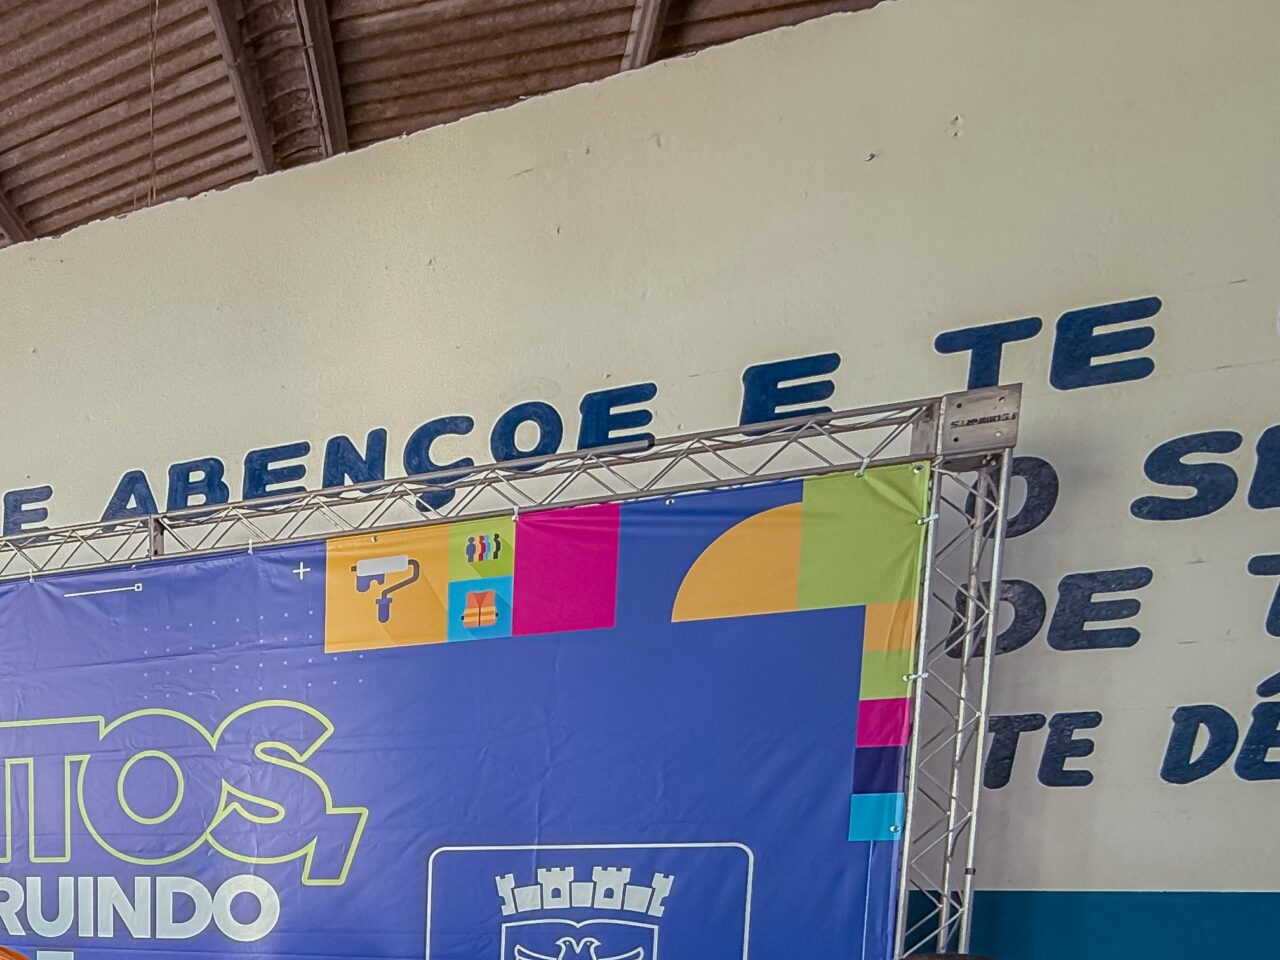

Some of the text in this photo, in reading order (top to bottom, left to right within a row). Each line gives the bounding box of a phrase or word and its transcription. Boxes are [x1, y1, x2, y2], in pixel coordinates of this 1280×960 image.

[98, 382, 657, 512] ABENÇOE
[740, 352, 841, 437] E
[934, 296, 1162, 391] TE
[945, 566, 1154, 659] DE
[982, 710, 1103, 790] TE
